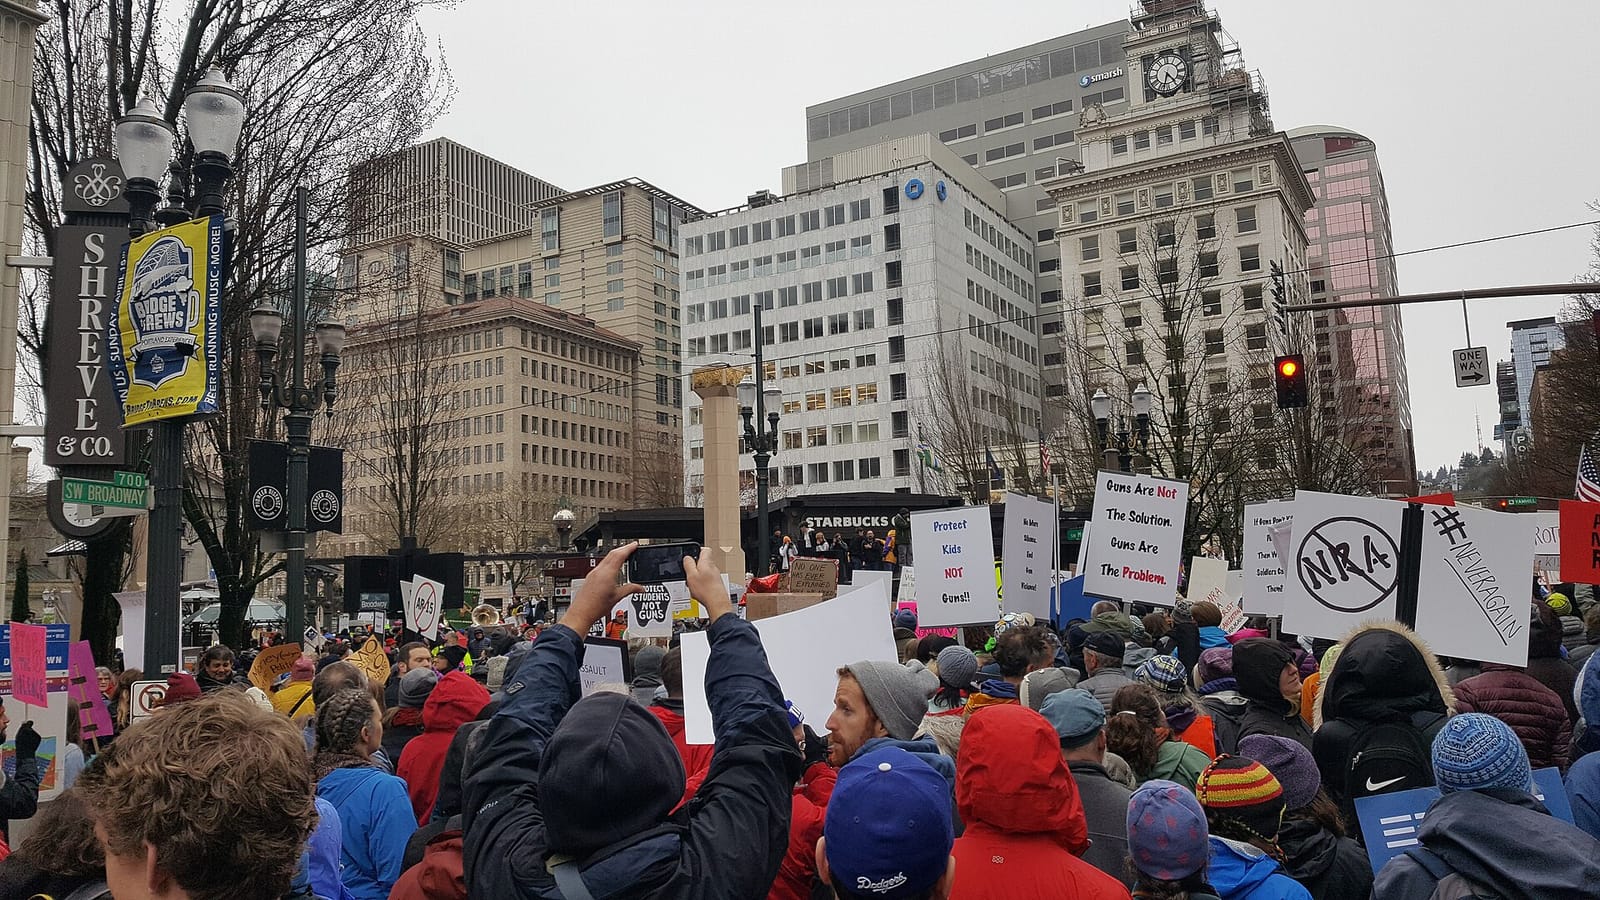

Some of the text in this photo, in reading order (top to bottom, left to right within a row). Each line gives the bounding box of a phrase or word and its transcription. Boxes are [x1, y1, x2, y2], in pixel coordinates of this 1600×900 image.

[1091, 67, 1123, 83] smarsh
[204, 226, 221, 405] BEER RUNNING MUSIC MORE!
[75, 232, 109, 431] SHREVE
[109, 312, 121, 362] SUNDAY
[1459, 350, 1481, 361] ONE
[1459, 360, 1483, 371] WAY
[114, 370, 127, 386] US
[57, 436, 114, 457] & CO.
[118, 473, 142, 487] 700
[65, 482, 145, 505] SW BROADWAY
[1106, 480, 1178, 499] Guns Are Not
[805, 516, 889, 528] STARBUCKS
[1106, 508, 1173, 528] The Solution.
[933, 520, 968, 533] Protect
[942, 544, 962, 555] Kids
[1110, 536, 1159, 555] Guns Are
[1302, 535, 1391, 590] NRA
[944, 567, 963, 579] NOT
[1101, 563, 1167, 585] The Problem.
[361, 600, 388, 609] Broadway
[632, 592, 670, 602] STUDENTS
[942, 591, 971, 604] Guns!!
[641, 601, 661, 611] NOT
[638, 610, 665, 621] GUNS
[580, 665, 607, 676] SSAULT
[856, 871, 908, 894] Dodgers
